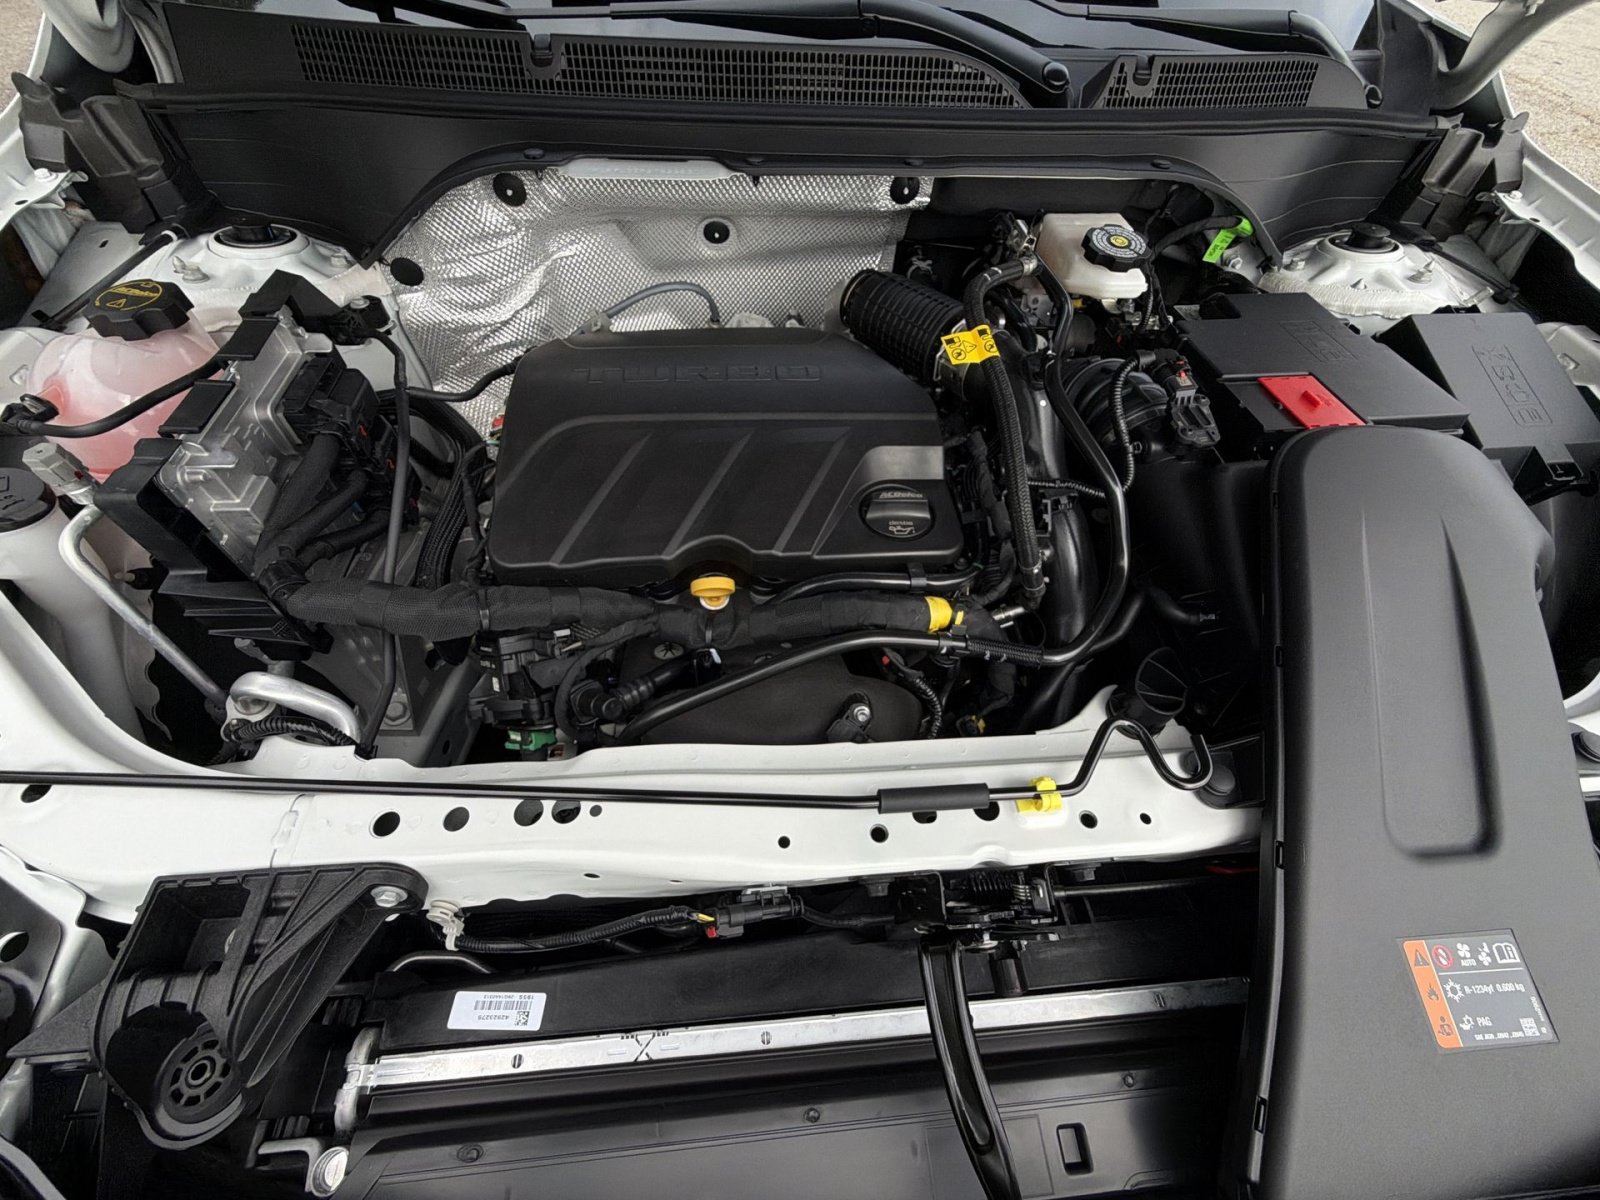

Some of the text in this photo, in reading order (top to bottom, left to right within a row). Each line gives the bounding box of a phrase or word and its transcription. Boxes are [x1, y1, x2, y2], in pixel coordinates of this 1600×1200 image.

[573, 365, 821, 383] TURBO
[1460, 958, 1477, 967] AUTO
[1514, 982, 1526, 993] kg
[1476, 1016, 1493, 1027] PAG
